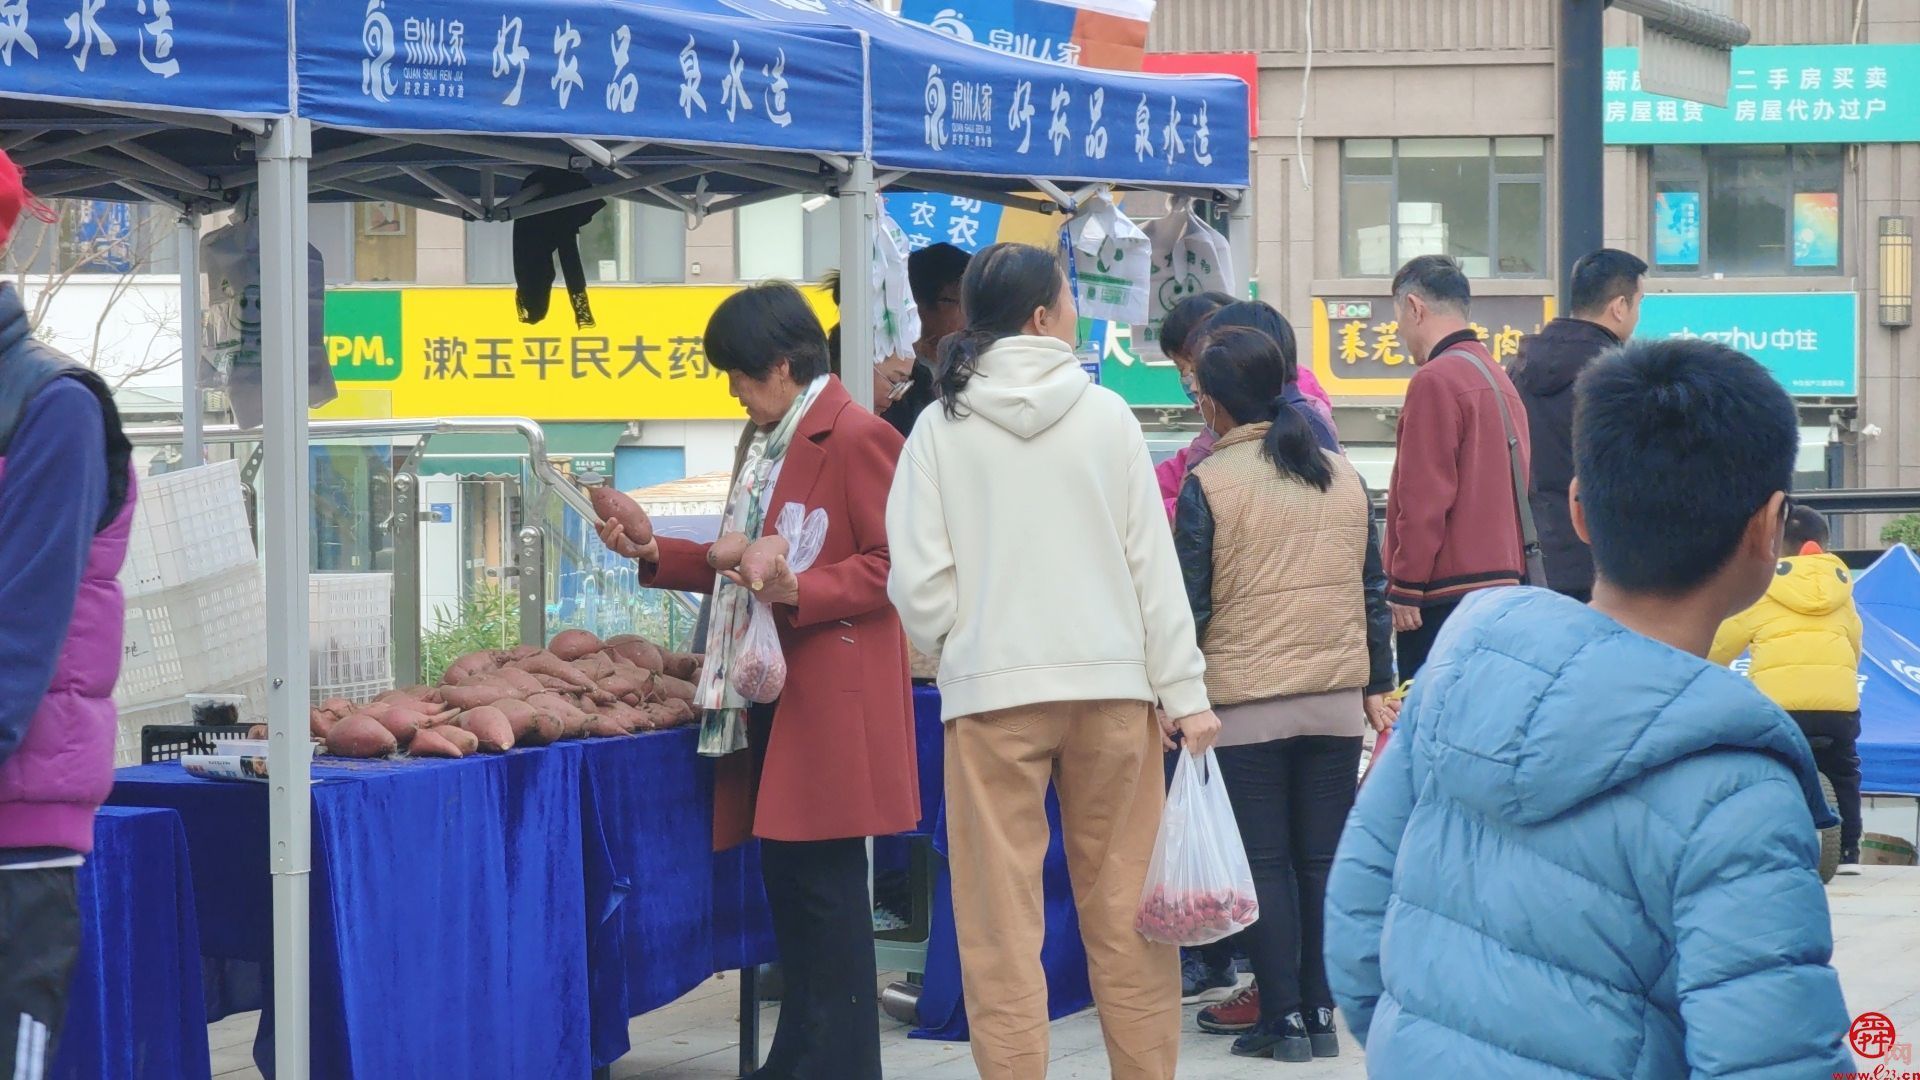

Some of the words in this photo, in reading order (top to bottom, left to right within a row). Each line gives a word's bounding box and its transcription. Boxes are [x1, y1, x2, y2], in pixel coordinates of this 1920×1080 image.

[403, 67, 421, 80] QUAN
[422, 69, 438, 81] SHUI
[440, 70, 453, 81] REN
[1735, 67, 1889, 91] 二手房买卖
[1605, 100, 1704, 123] 房屋租赁
[1734, 98, 1887, 122] 房屋代办过户
[324, 335, 395, 367] PM.
[1770, 328, 1819, 350] 中住
[423, 336, 727, 381] 漱玉平民大药
